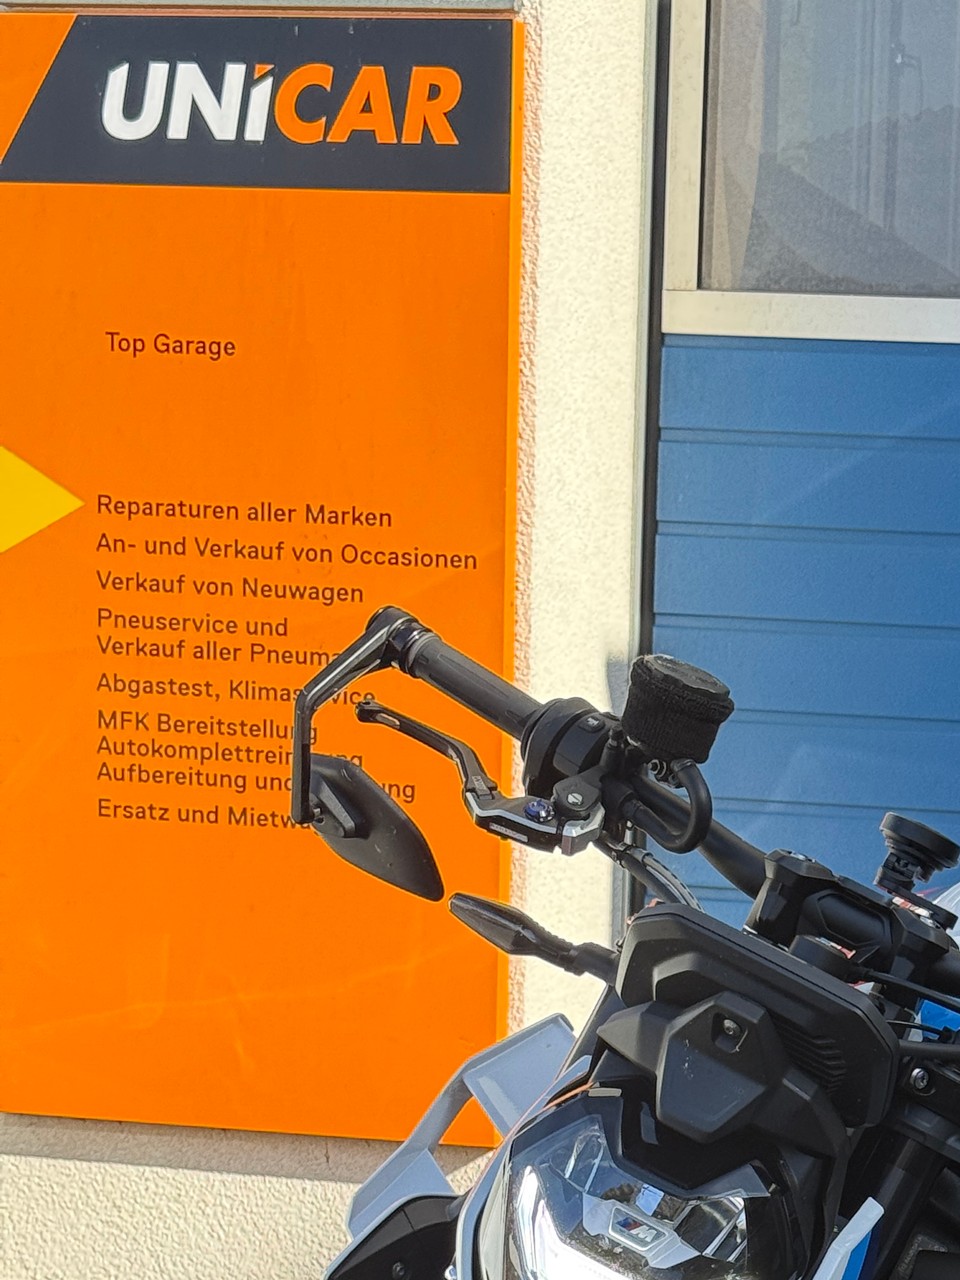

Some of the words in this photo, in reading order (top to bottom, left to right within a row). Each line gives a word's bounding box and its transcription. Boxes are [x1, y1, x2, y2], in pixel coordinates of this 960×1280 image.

[105, 331, 146, 358] Top
[153, 333, 236, 361] Garage
[97, 494, 239, 521] Reparaturen
[247, 501, 297, 523] aller
[305, 503, 392, 527] Marken
[96, 532, 136, 553] An-
[145, 536, 186, 556] und
[194, 537, 285, 560] Verkauf
[292, 546, 333, 563] von
[341, 543, 477, 570] Occasionen
[96, 570, 186, 593] Verkauf
[193, 580, 233, 596] von
[242, 577, 363, 606] Neuwagen
[97, 607, 238, 634] Pneuservice
[246, 617, 288, 636] und
[96, 635, 186, 659] Verkauf
[193, 640, 242, 662] aller
[96, 672, 220, 702] Abgastest,
[229, 679, 375, 705] Klimasvice
[97, 709, 150, 732] MFK
[157, 713, 317, 745] Bereitstellug
[96, 762, 247, 794] Aufbereitung
[97, 798, 170, 822] Ersatz
[178, 805, 219, 824] und
[228, 806, 319, 835] Mietw
